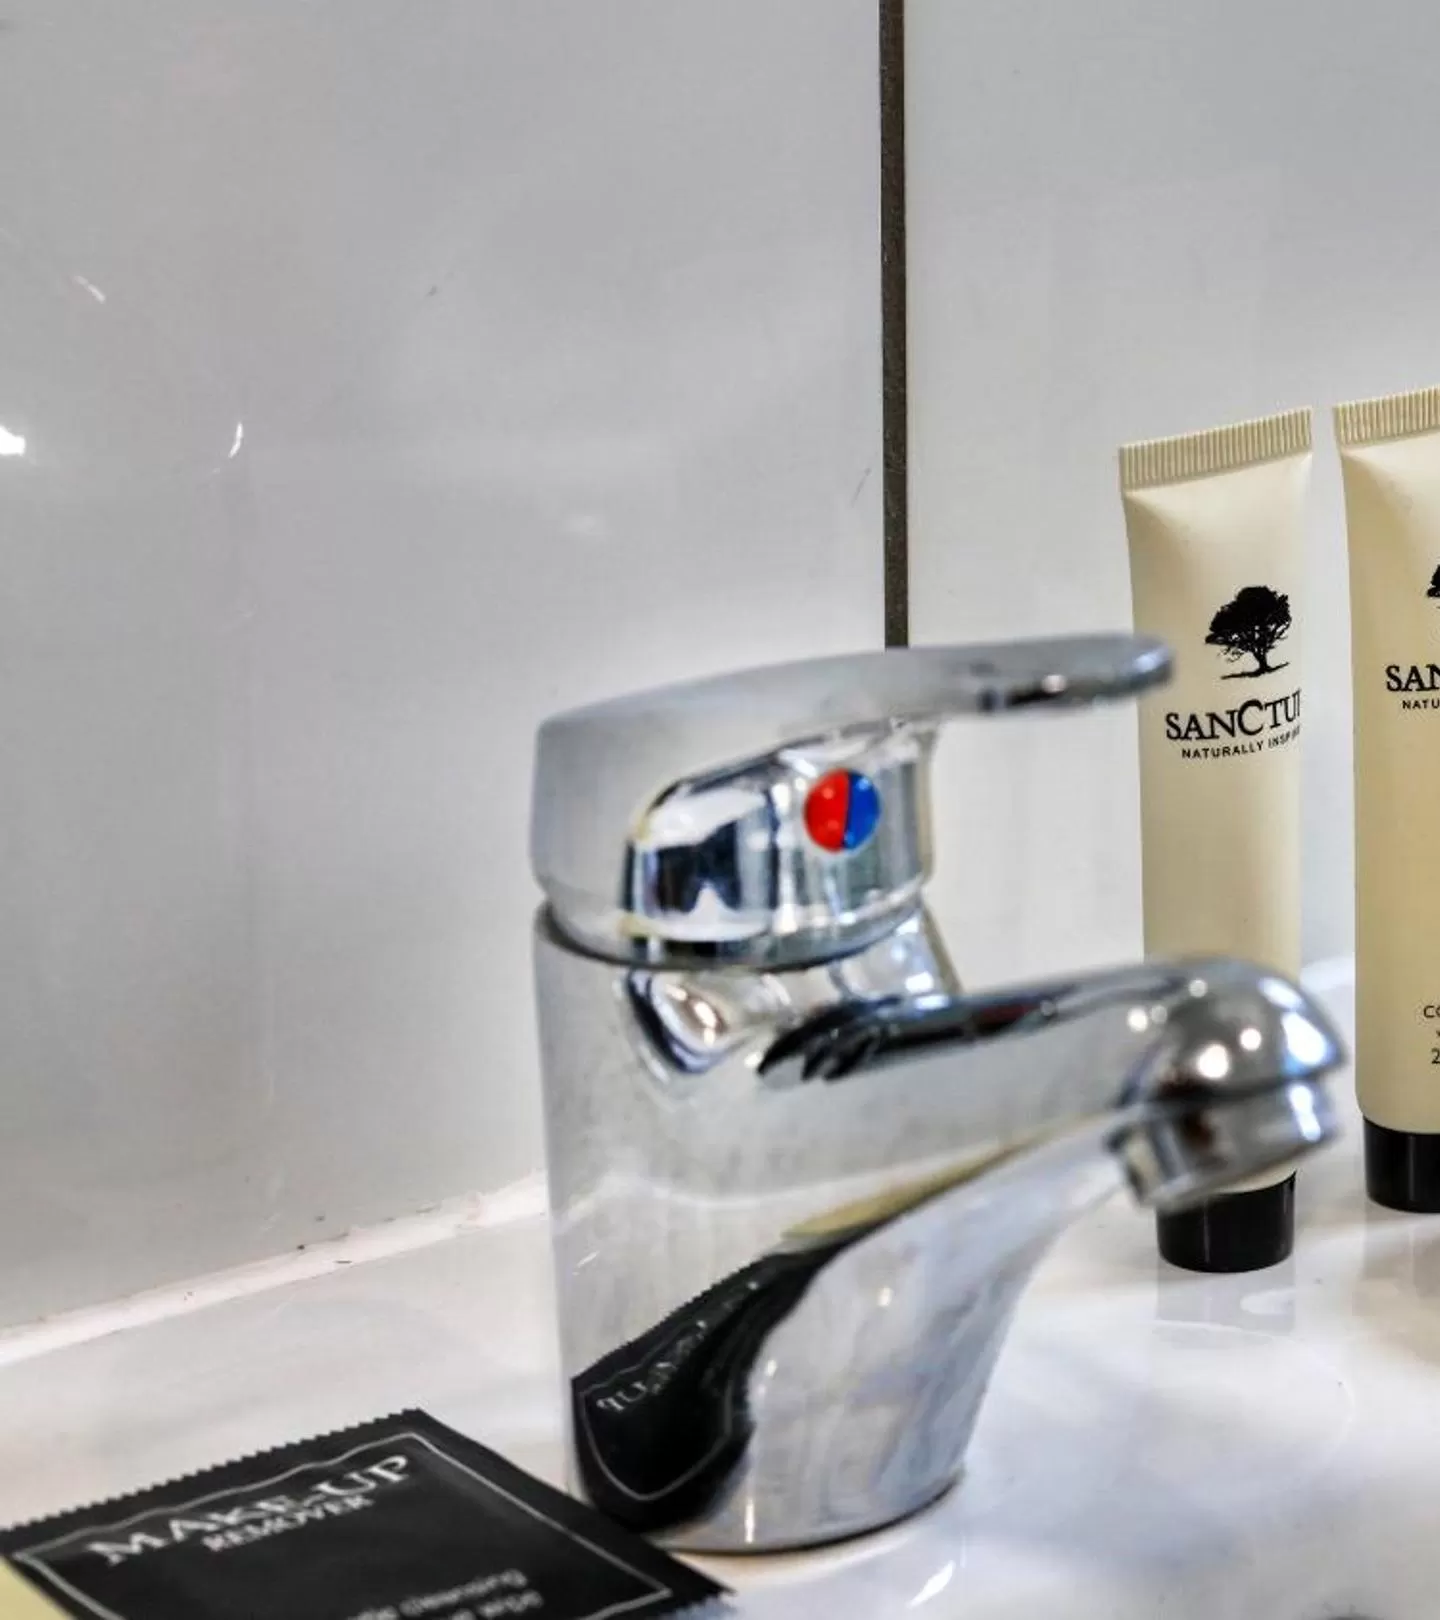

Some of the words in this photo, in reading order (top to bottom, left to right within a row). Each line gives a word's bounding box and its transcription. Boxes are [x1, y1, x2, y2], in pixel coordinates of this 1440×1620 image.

[1181, 740, 1264, 760] NATURALLY
[87, 1454, 409, 1567] MAKE-UP
[201, 1494, 376, 1552] REMOVER
